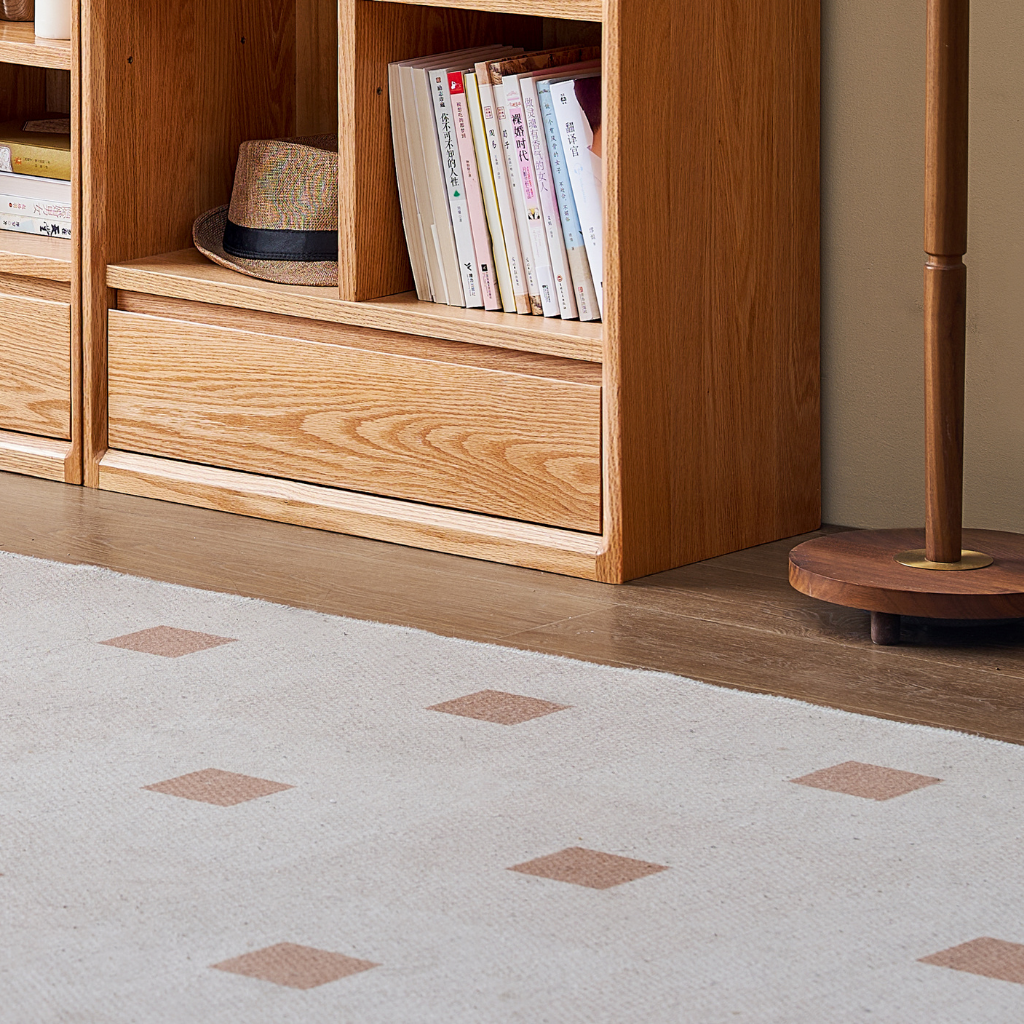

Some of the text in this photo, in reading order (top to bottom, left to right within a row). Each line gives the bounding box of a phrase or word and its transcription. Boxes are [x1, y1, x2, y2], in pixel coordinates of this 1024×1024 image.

[440, 112, 460, 187] 你不可不知的人性
[511, 113, 529, 162] 裸婚时代
[565, 121, 579, 157] 翻译官
